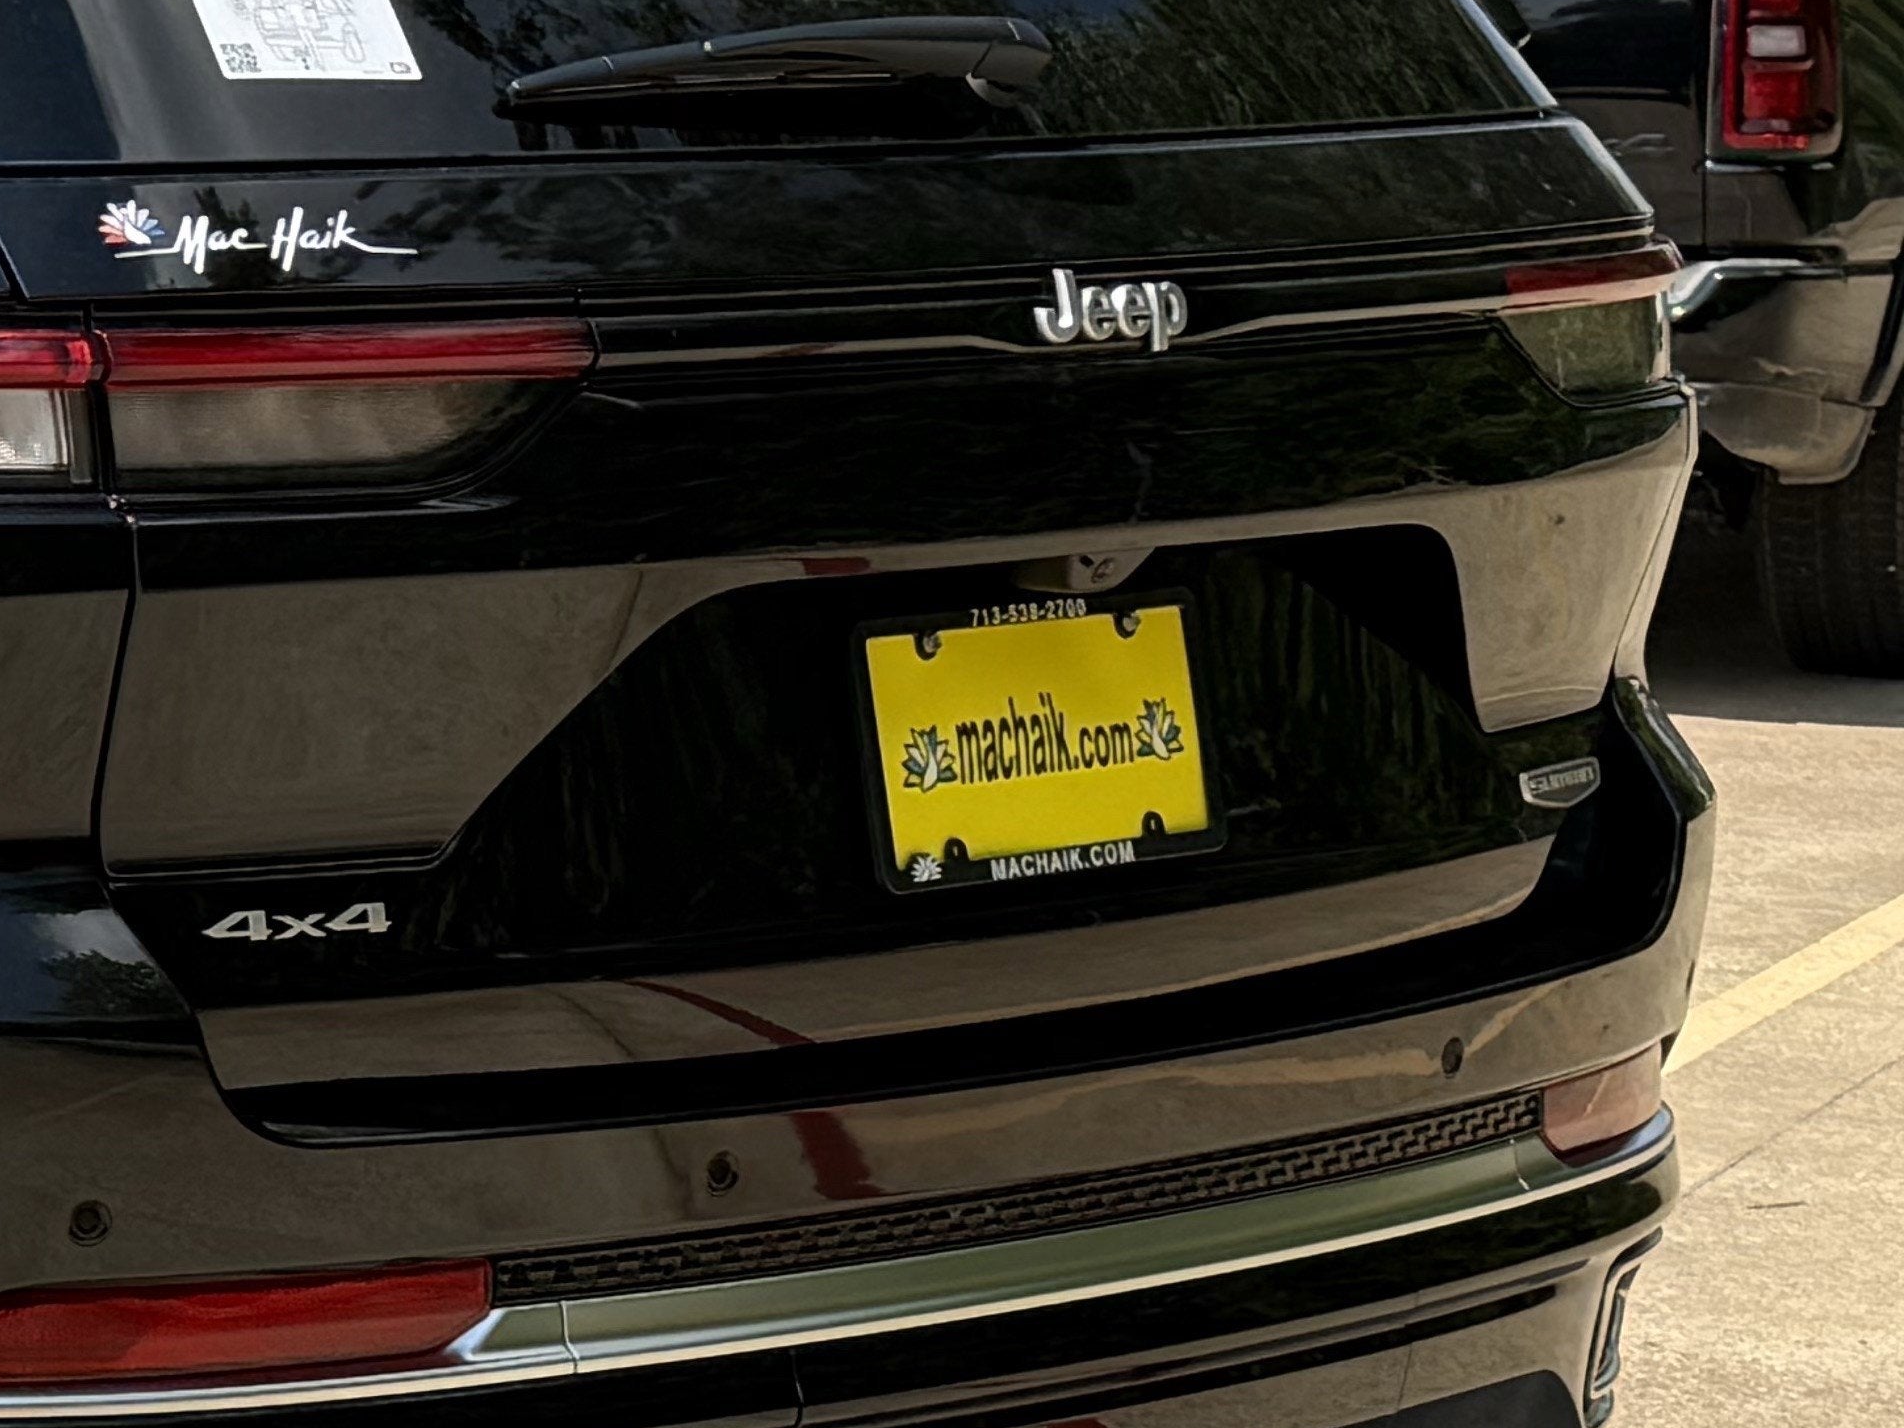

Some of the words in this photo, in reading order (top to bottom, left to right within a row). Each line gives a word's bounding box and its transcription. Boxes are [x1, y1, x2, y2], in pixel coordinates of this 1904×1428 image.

[115, 215, 268, 275] Mac
[271, 206, 418, 272] Haik
[1033, 268, 1188, 352] Jeep
[955, 691, 1135, 785] machaik.com
[991, 839, 1137, 882] MACHAIK.COM
[201, 901, 393, 941] 4x4
